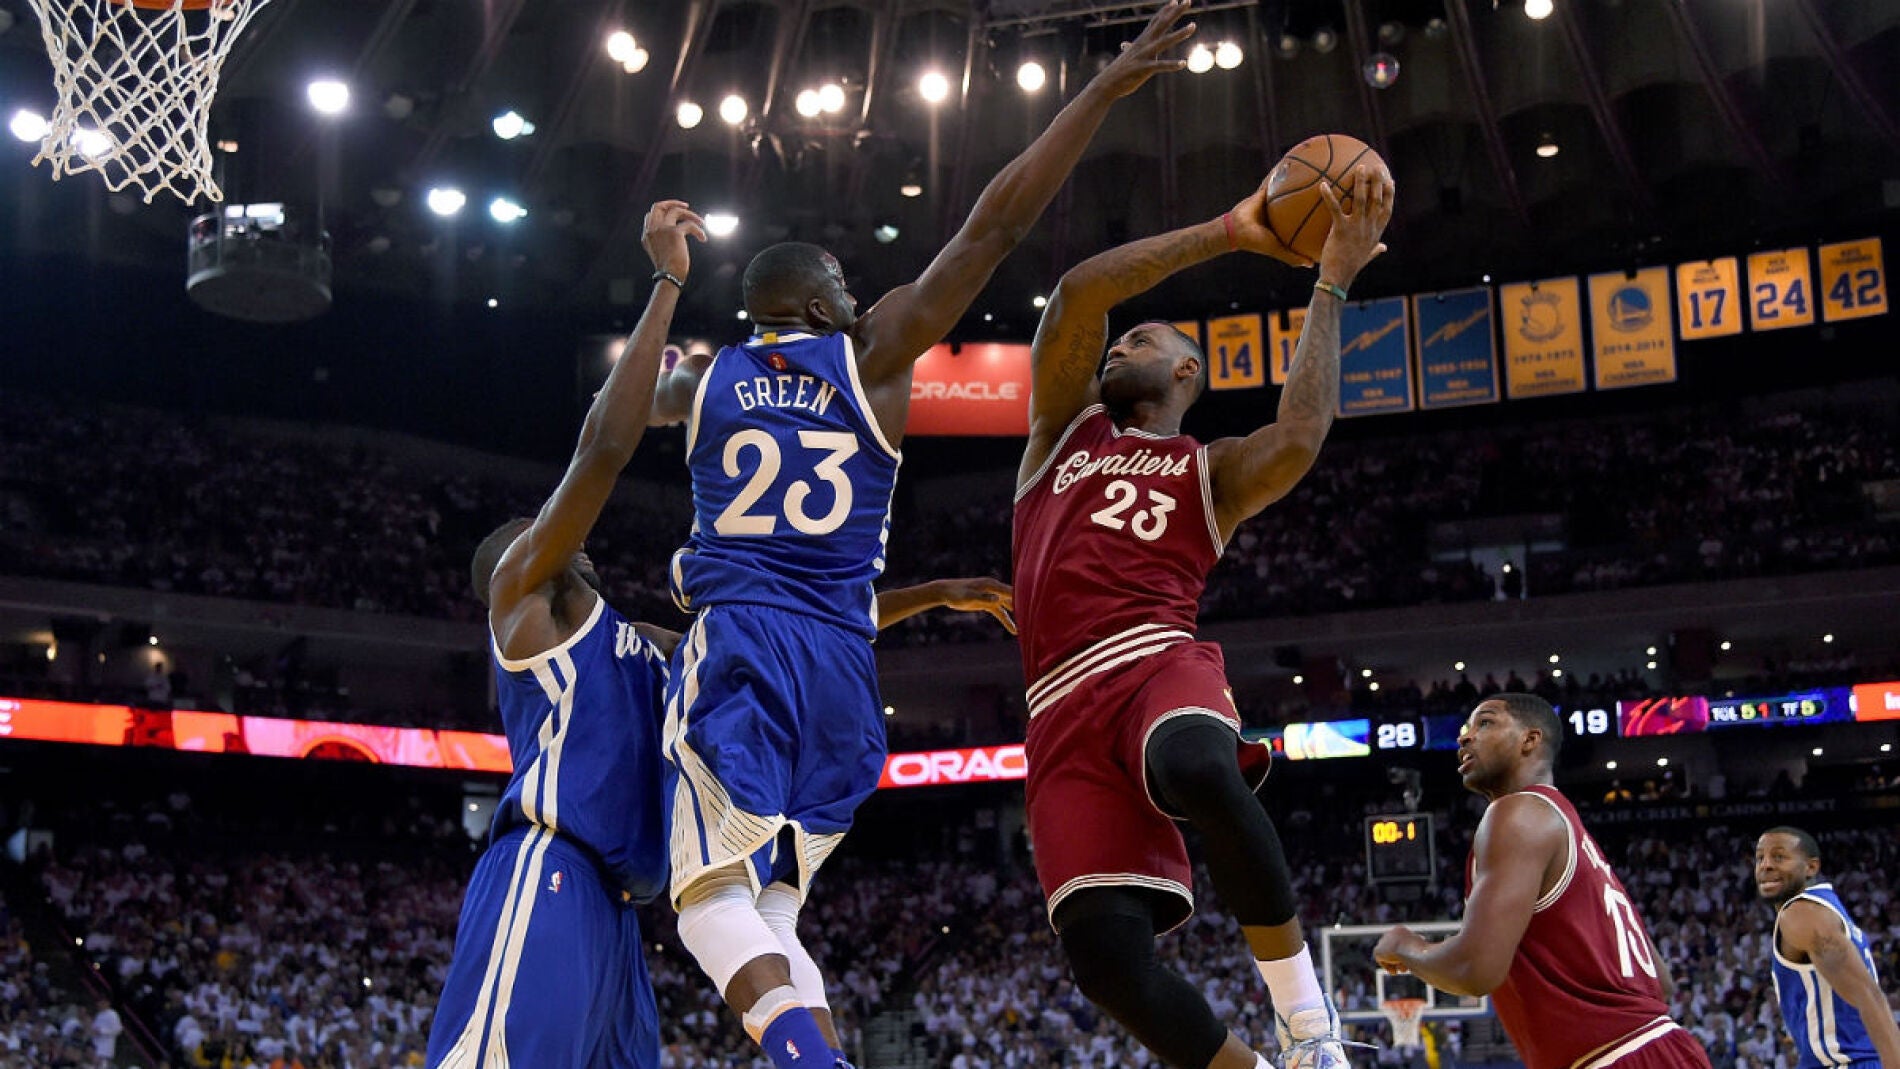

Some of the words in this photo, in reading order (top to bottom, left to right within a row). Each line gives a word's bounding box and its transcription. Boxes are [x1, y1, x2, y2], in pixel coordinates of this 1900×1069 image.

[1689, 288, 1726, 329] 17
[1755, 278, 1807, 320] 24
[1829, 269, 1882, 310] 42
[1218, 343, 1253, 379] 14
[1281, 338, 1300, 373] 1
[734, 375, 837, 416] GREEN
[911, 381, 1017, 400] ORACLE
[713, 428, 860, 535] 23
[1053, 448, 1191, 495] Cavaliers
[1090, 479, 1177, 542] 23
[1377, 722, 1417, 750] 28
[1568, 708, 1609, 736] 19
[889, 747, 1028, 785] ORAC
